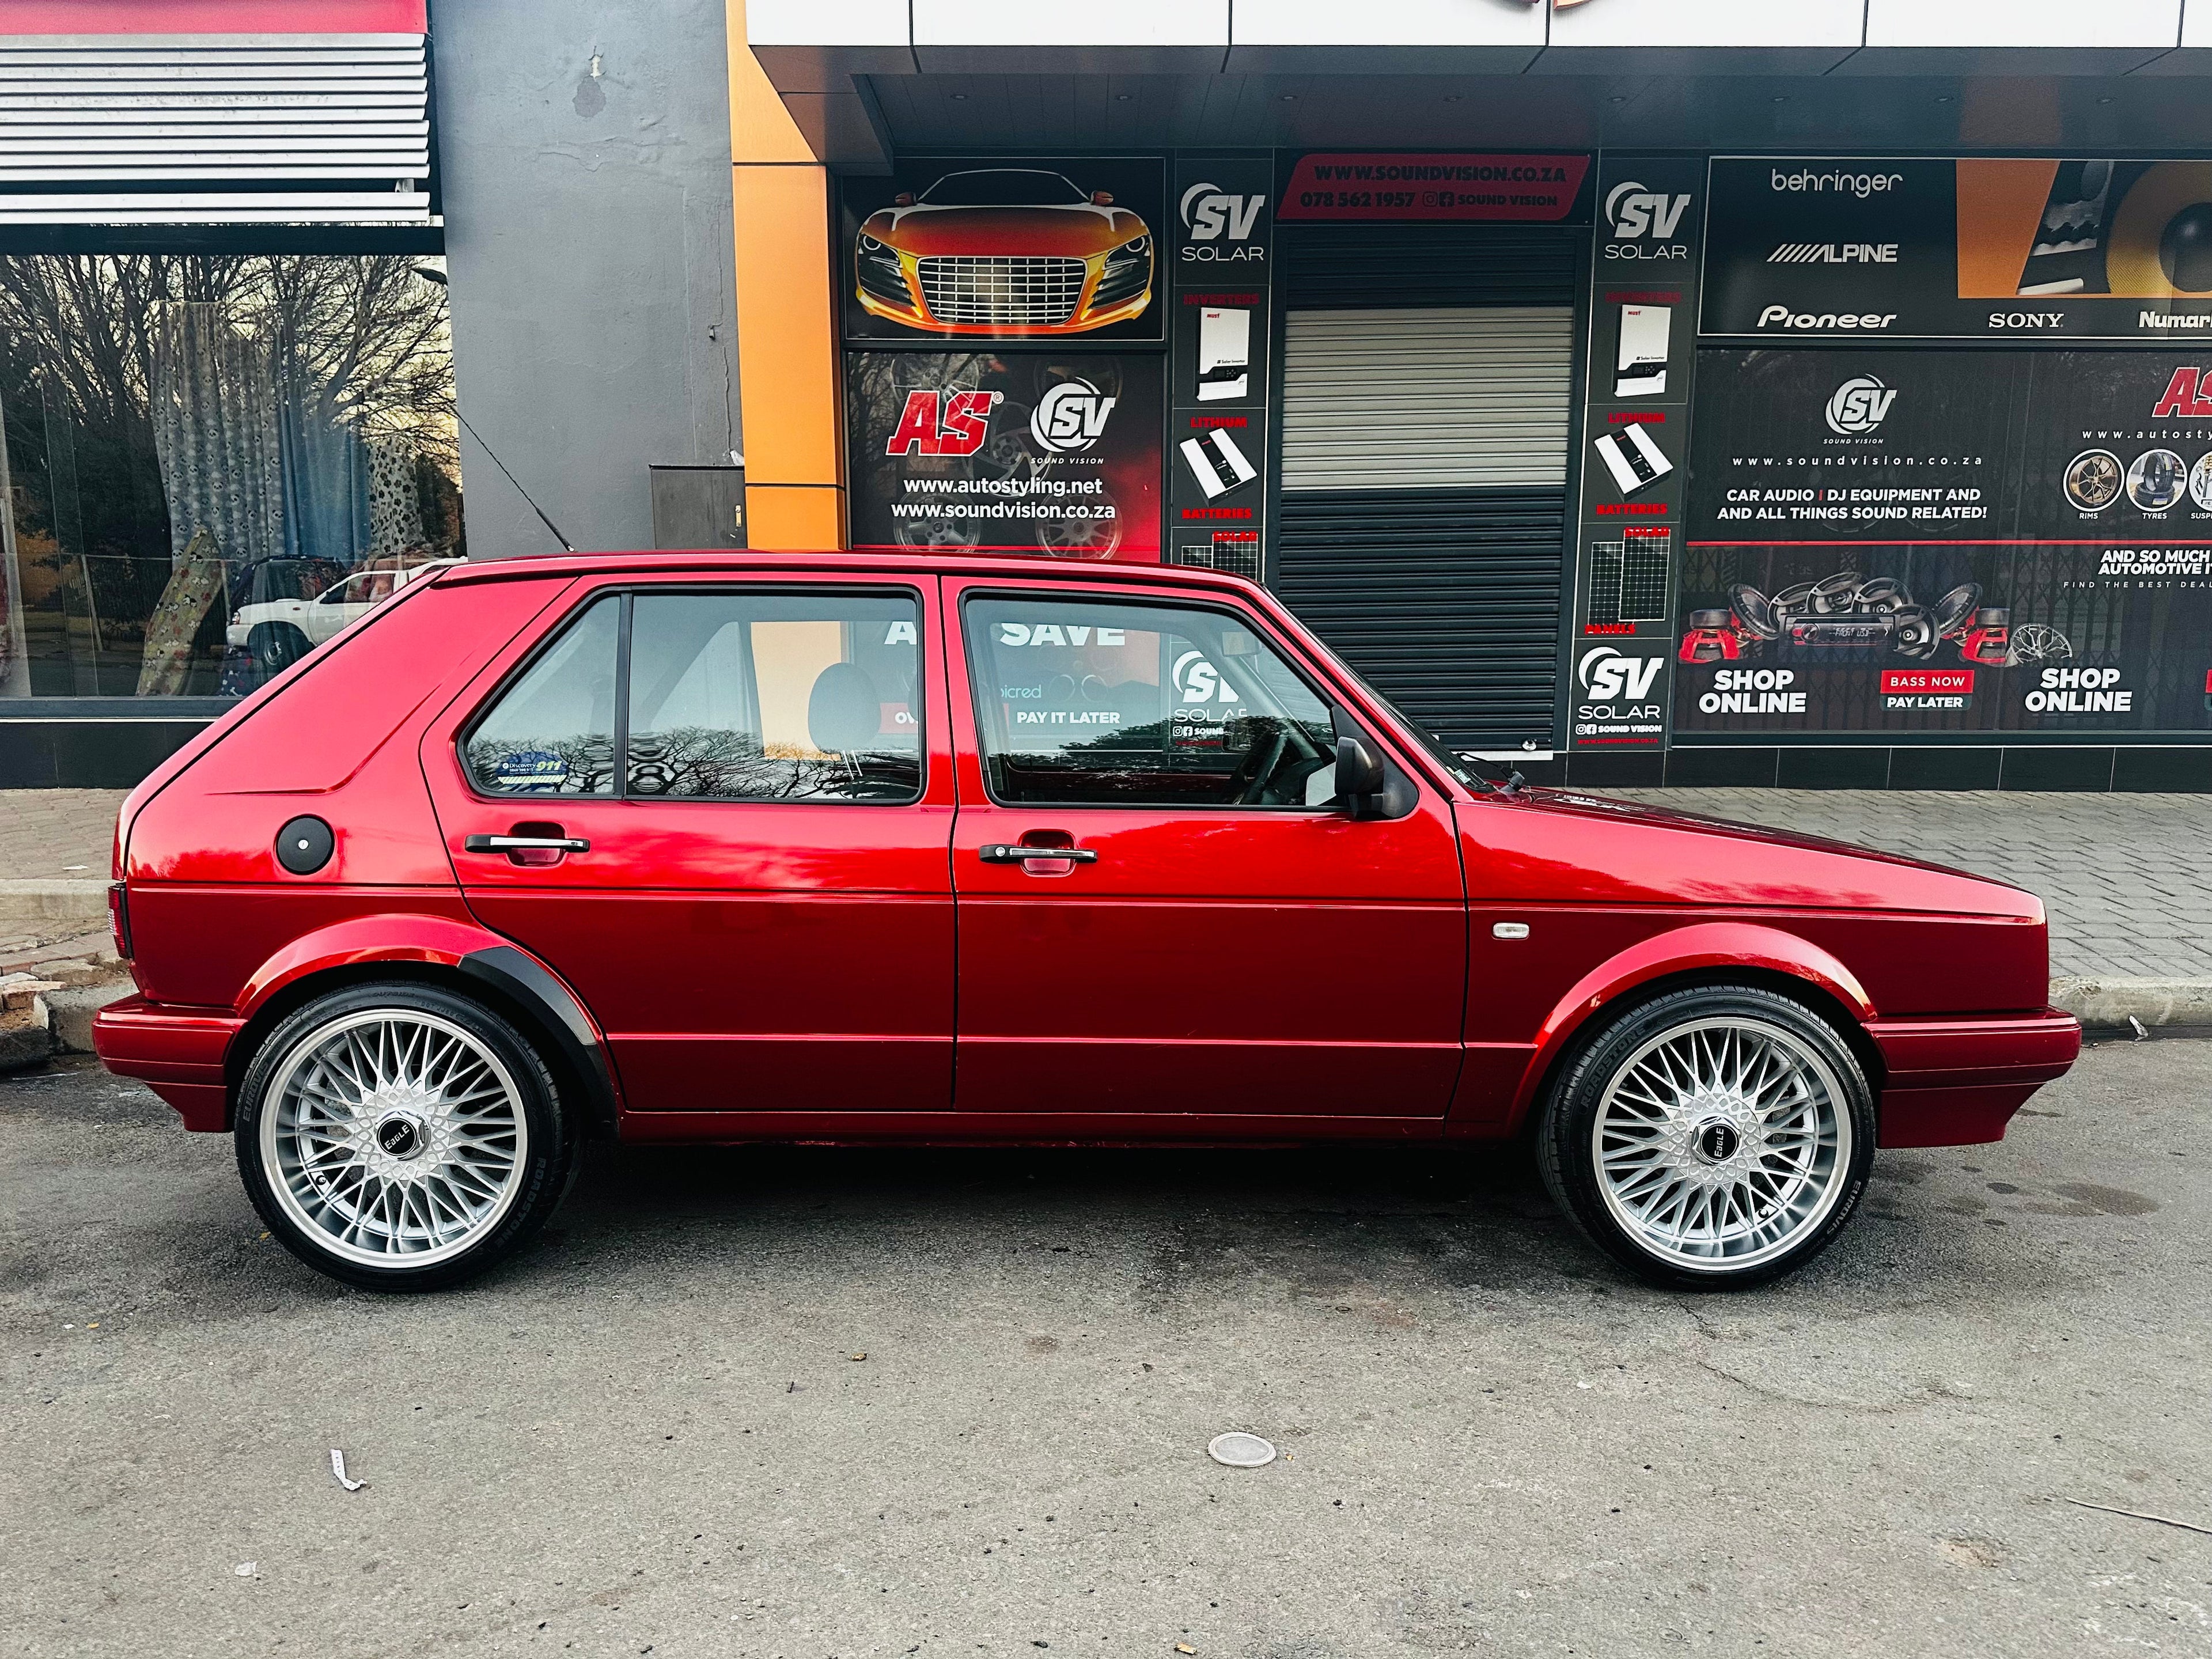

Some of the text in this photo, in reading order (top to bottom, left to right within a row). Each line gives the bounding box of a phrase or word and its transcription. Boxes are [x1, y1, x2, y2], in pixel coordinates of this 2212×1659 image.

[1314, 165, 1566, 181] WWW.SOUNDVISION.CO.ZA
[1771, 168, 1903, 198] behringer
[1338, 191, 1372, 207] 562
[1376, 191, 1416, 207] 1957
[1458, 194, 1506, 206] SOUND
[1510, 195, 1558, 207] VISION
[1190, 195, 1266, 240] SV
[1614, 194, 1692, 238] SV
[1181, 246, 1264, 261] SOLAR
[1604, 244, 1688, 259] SOLAR
[1808, 244, 1899, 263] ALPINE
[1183, 293, 1260, 305] INVERTERS
[1757, 304, 1897, 329] Pioneer
[1988, 313, 2064, 328] SONY
[2138, 311, 2212, 328] Numar
[1841, 389, 1897, 422] SV
[885, 389, 995, 457] AS
[1050, 396, 1116, 437] SV
[1190, 417, 1248, 428] LITHIUM
[1608, 412, 1666, 423] LITHIUM
[1732, 455, 1982, 466] www.soundvision.co.za
[903, 478, 1103, 497] www.autostyling.net
[1726, 488, 1981, 502] CAR AUDIO DJ EQUIPMENT AND
[891, 501, 1116, 519] www.soundvision.co.za
[1182, 508, 1252, 519] BATTERIES
[1596, 503, 1668, 515] BATTERIES
[1717, 507, 1987, 520] AND ALL THINGS SOUND RELATED!
[1213, 531, 1258, 542] SOLAR
[1624, 527, 1671, 537] SOLAR
[2100, 550, 2210, 563] AND SO MUCH
[2098, 563, 2202, 575] AUTOMOTIVE
[1000, 623, 1125, 646] SAVE
[1585, 623, 1636, 634] PANELS
[1588, 657, 1665, 700] SV
[1713, 669, 1794, 691] SHOP
[1890, 676, 1965, 687] BASS NOW
[2040, 668, 2120, 689] SHOP
[1699, 692, 1807, 714] ONLINE
[1887, 696, 1963, 708] PAY LATER
[2025, 691, 2133, 712] ONLINE
[1017, 711, 1120, 724] PAY IT LATER
[1578, 704, 1661, 719] SOLAR
[1597, 724, 1662, 734] SOUND VISION
[535, 760, 562, 771] 911
[1582, 1025, 1647, 1109] ROADSTONE
[242, 1060, 269, 1123] EUROVIS
[494, 1157, 547, 1249] ROADSTONE
[1826, 1180, 1862, 1235] EUROVIS
